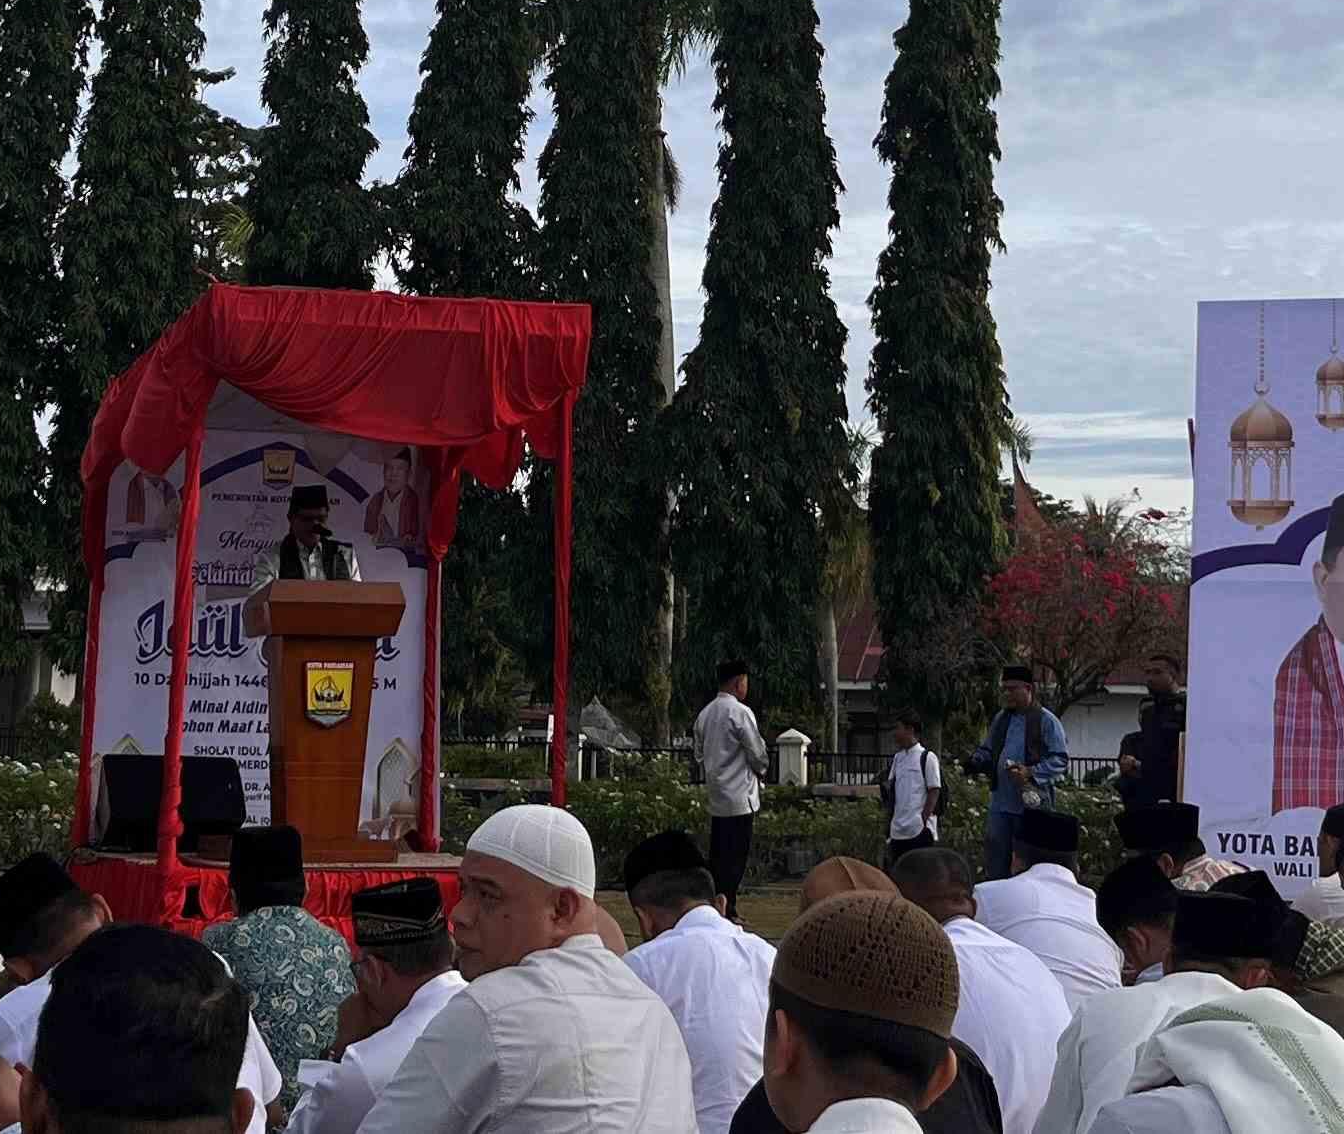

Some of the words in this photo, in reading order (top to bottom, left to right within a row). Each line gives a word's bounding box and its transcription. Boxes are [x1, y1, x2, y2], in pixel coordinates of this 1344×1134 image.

[135, 672, 150, 686] 10
[189, 699, 229, 715] Minal
[217, 719, 253, 734] Maaf
[194, 745, 236, 756] SHOLAT
[238, 746, 263, 756] IDUL
[1218, 833, 1275, 855] YOTA
[1274, 861, 1313, 878] WALI
